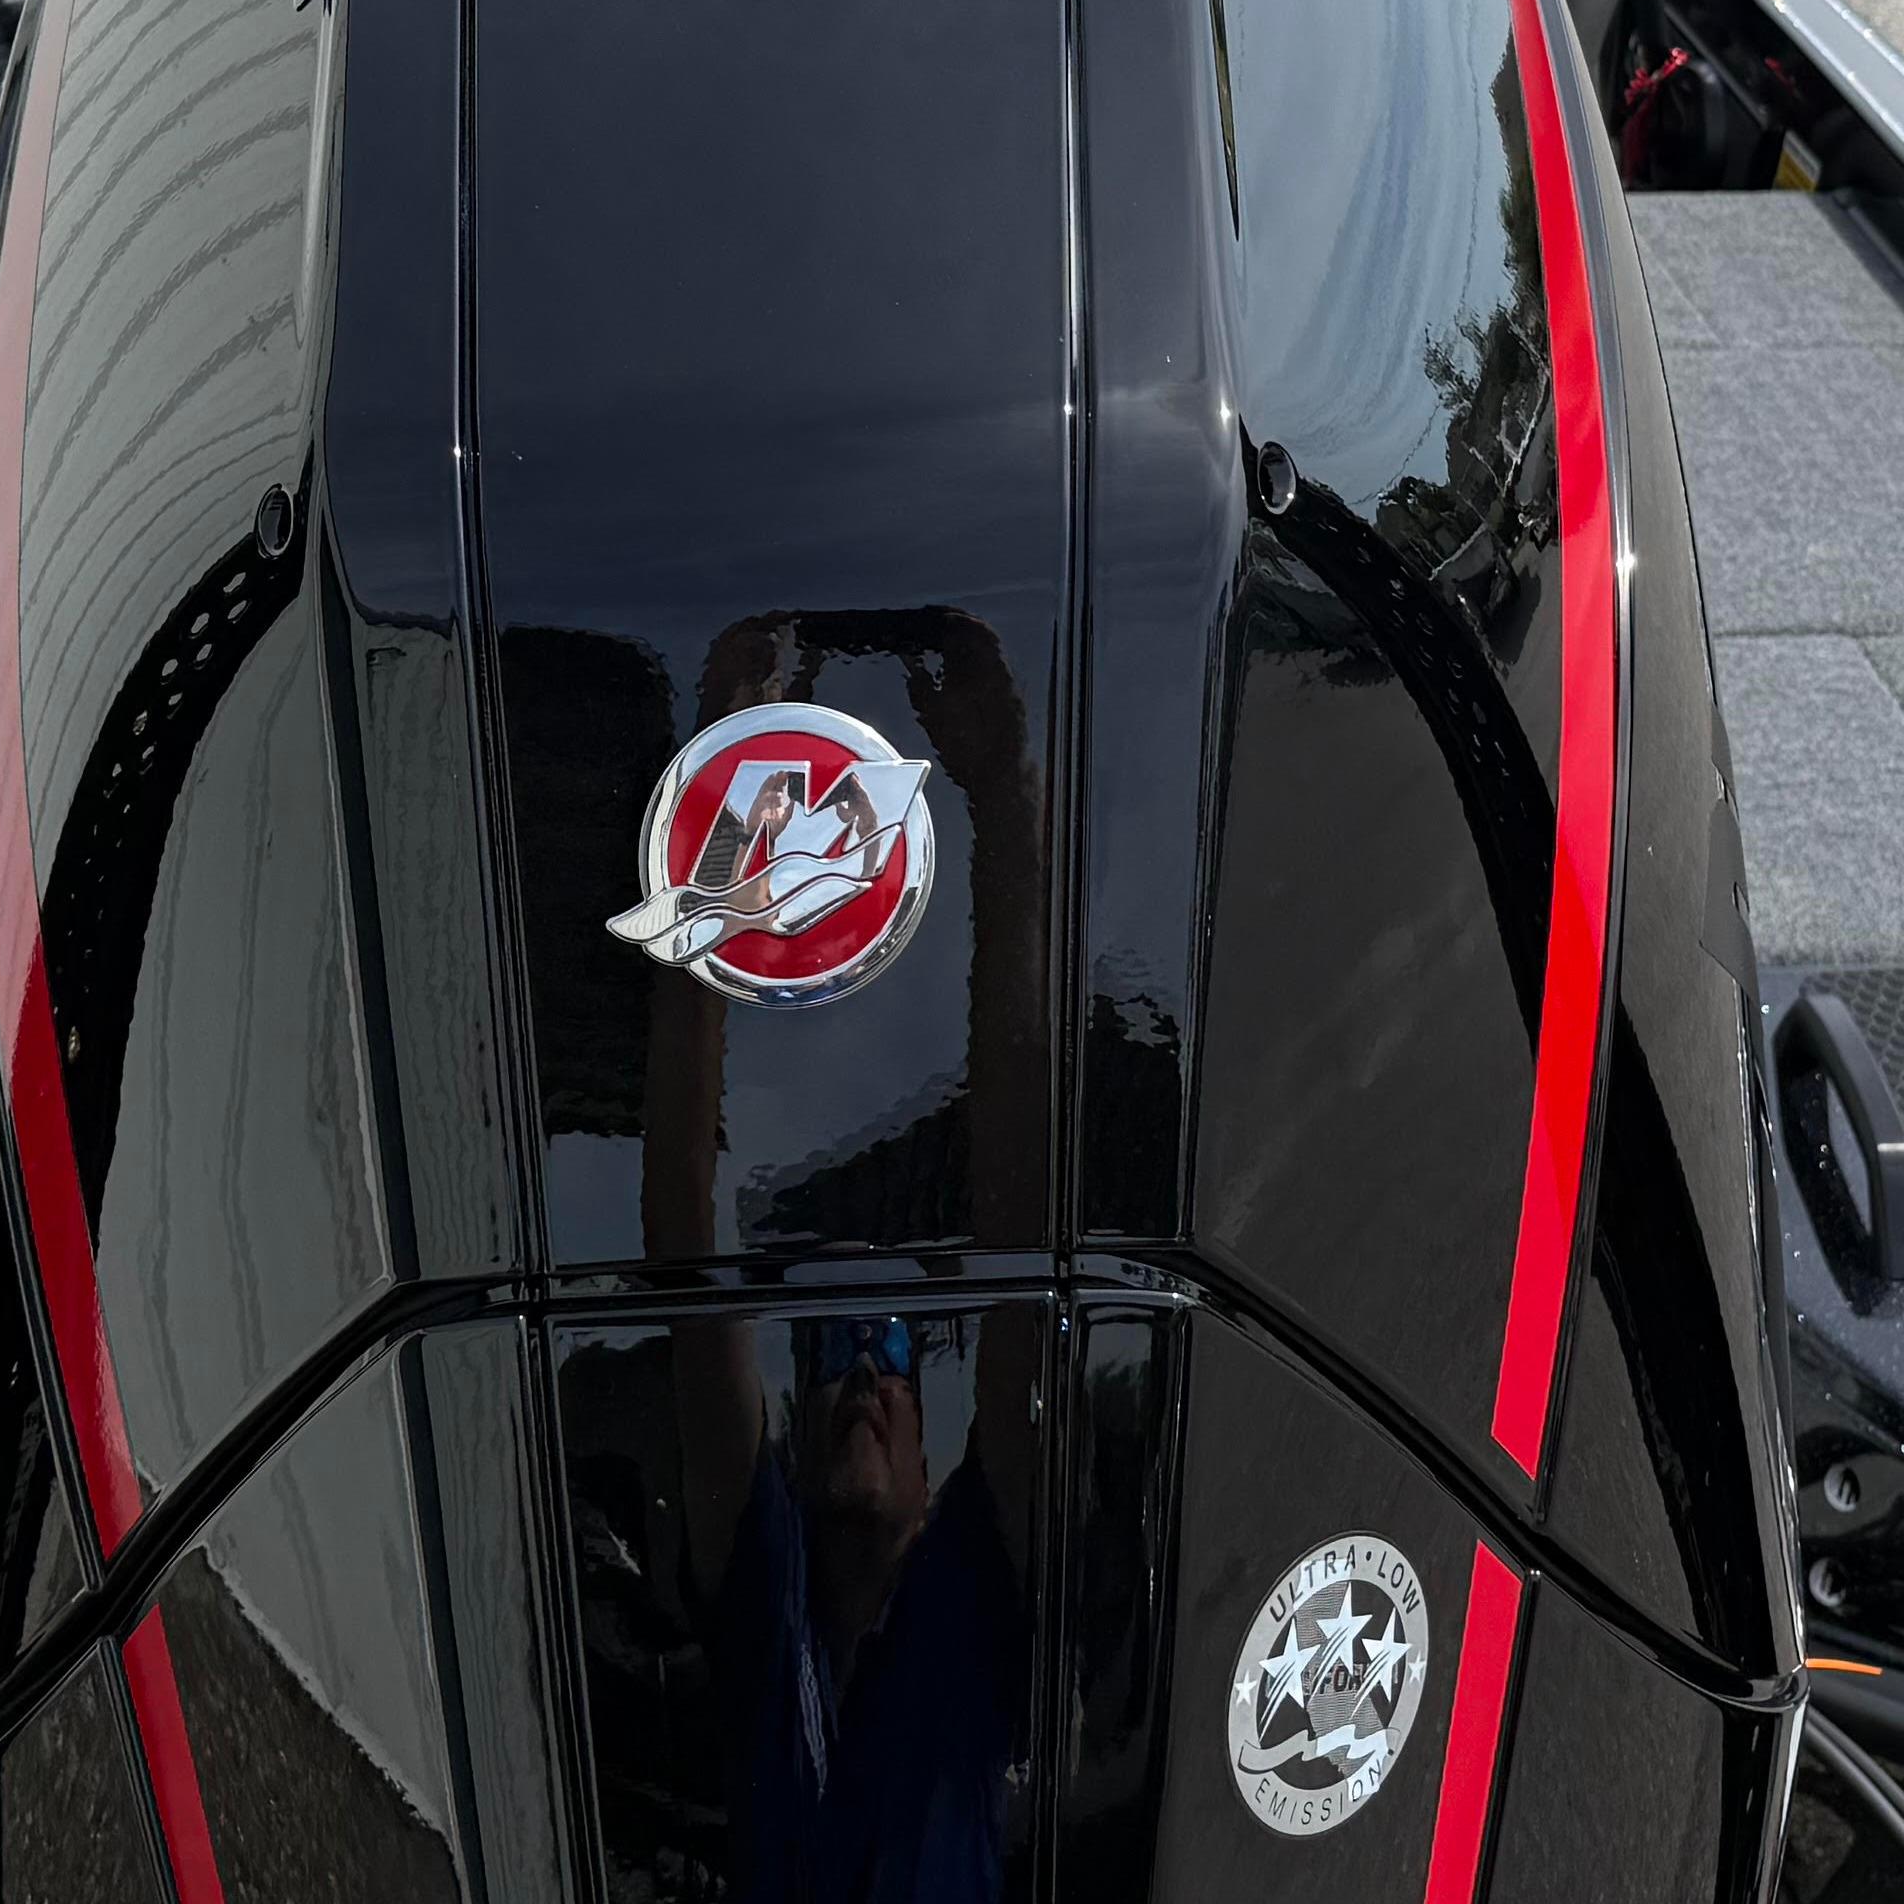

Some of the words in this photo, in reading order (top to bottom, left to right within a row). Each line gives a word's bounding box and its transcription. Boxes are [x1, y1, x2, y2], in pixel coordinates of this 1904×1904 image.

[1268, 1543, 1357, 1624] ULTRA
[1376, 1549, 1421, 1615] LOW
[1253, 1760, 1385, 1826] EMISSION
